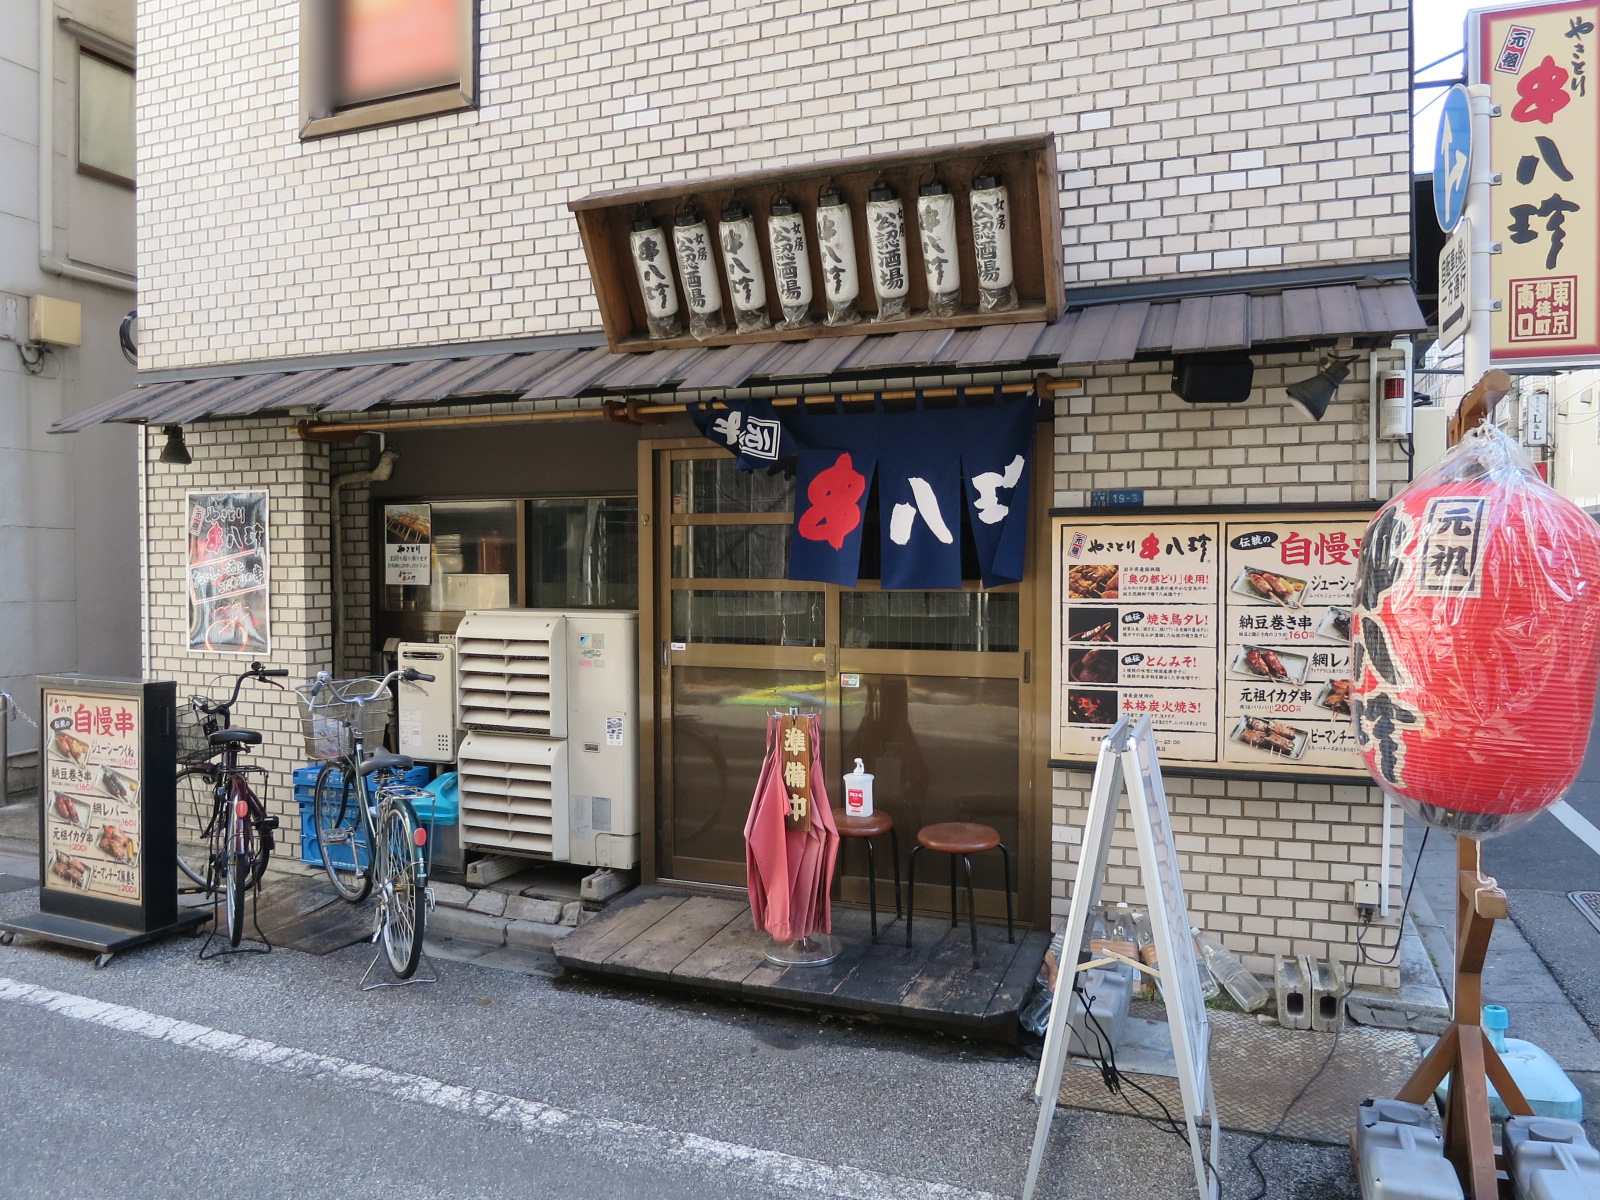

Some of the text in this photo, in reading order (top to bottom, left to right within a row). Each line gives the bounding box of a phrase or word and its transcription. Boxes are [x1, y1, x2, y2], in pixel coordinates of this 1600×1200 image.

[1501, 32, 1527, 69] 元祖
[1564, 16, 1595, 97] やきとり
[994, 197, 1006, 230] 女房
[694, 233, 707, 261] 女房
[791, 222, 804, 251] 女房
[873, 211, 904, 290] 公認酒場
[971, 201, 1000, 282] 公認酒場
[677, 236, 706, 309] 公認酒場
[771, 225, 802, 301] 公認酒場
[1441, 265, 1467, 308] 一方通行
[1517, 284, 1534, 336] 南口
[1535, 283, 1551, 335] 御徒町
[1552, 282, 1569, 335] 東京
[204, 506, 245, 524] やきとり
[1112, 493, 1138, 504] 19-3
[396, 544, 421, 554] やきとり
[1087, 538, 1136, 555] やきとり
[1238, 535, 1271, 548] 伝統の
[1431, 506, 1473, 578] 元祖
[1238, 613, 1313, 631] 納豆巻き串
[1239, 687, 1312, 704] 元祖イカダ串
[74, 703, 135, 739] 自慢串
[91, 740, 134, 758] ジューシーつくね
[51, 766, 92, 783] 納豆巻き串
[784, 727, 808, 822] 準備中
[92, 802, 129, 816] 網レバー
[52, 827, 94, 845] 元祖イカダ串
